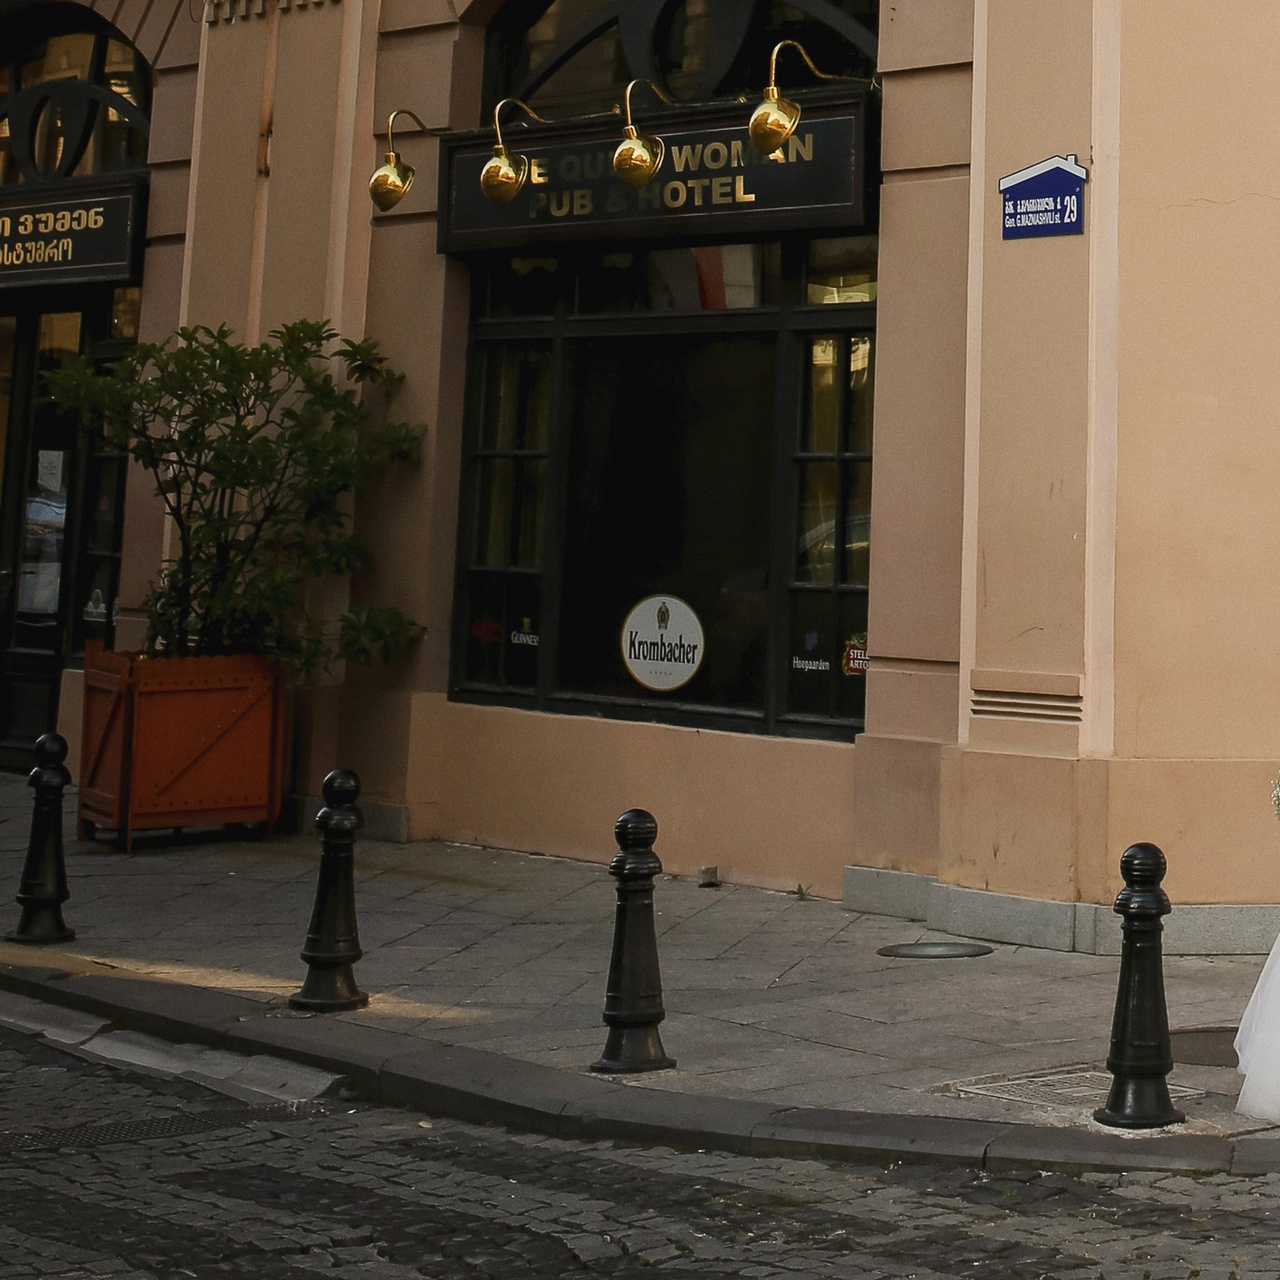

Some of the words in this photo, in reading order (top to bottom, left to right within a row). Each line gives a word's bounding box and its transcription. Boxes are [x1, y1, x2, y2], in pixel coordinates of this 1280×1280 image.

[529, 188, 593, 219] PUB
[637, 175, 756, 211] HOTEL
[1064, 195, 1077, 223] 29
[18, 207, 104, 235] ვუმენ
[0, 238, 73, 266] სტუმრო
[628, 630, 698, 665] Krombacher
[849, 649, 870, 660] STELL
